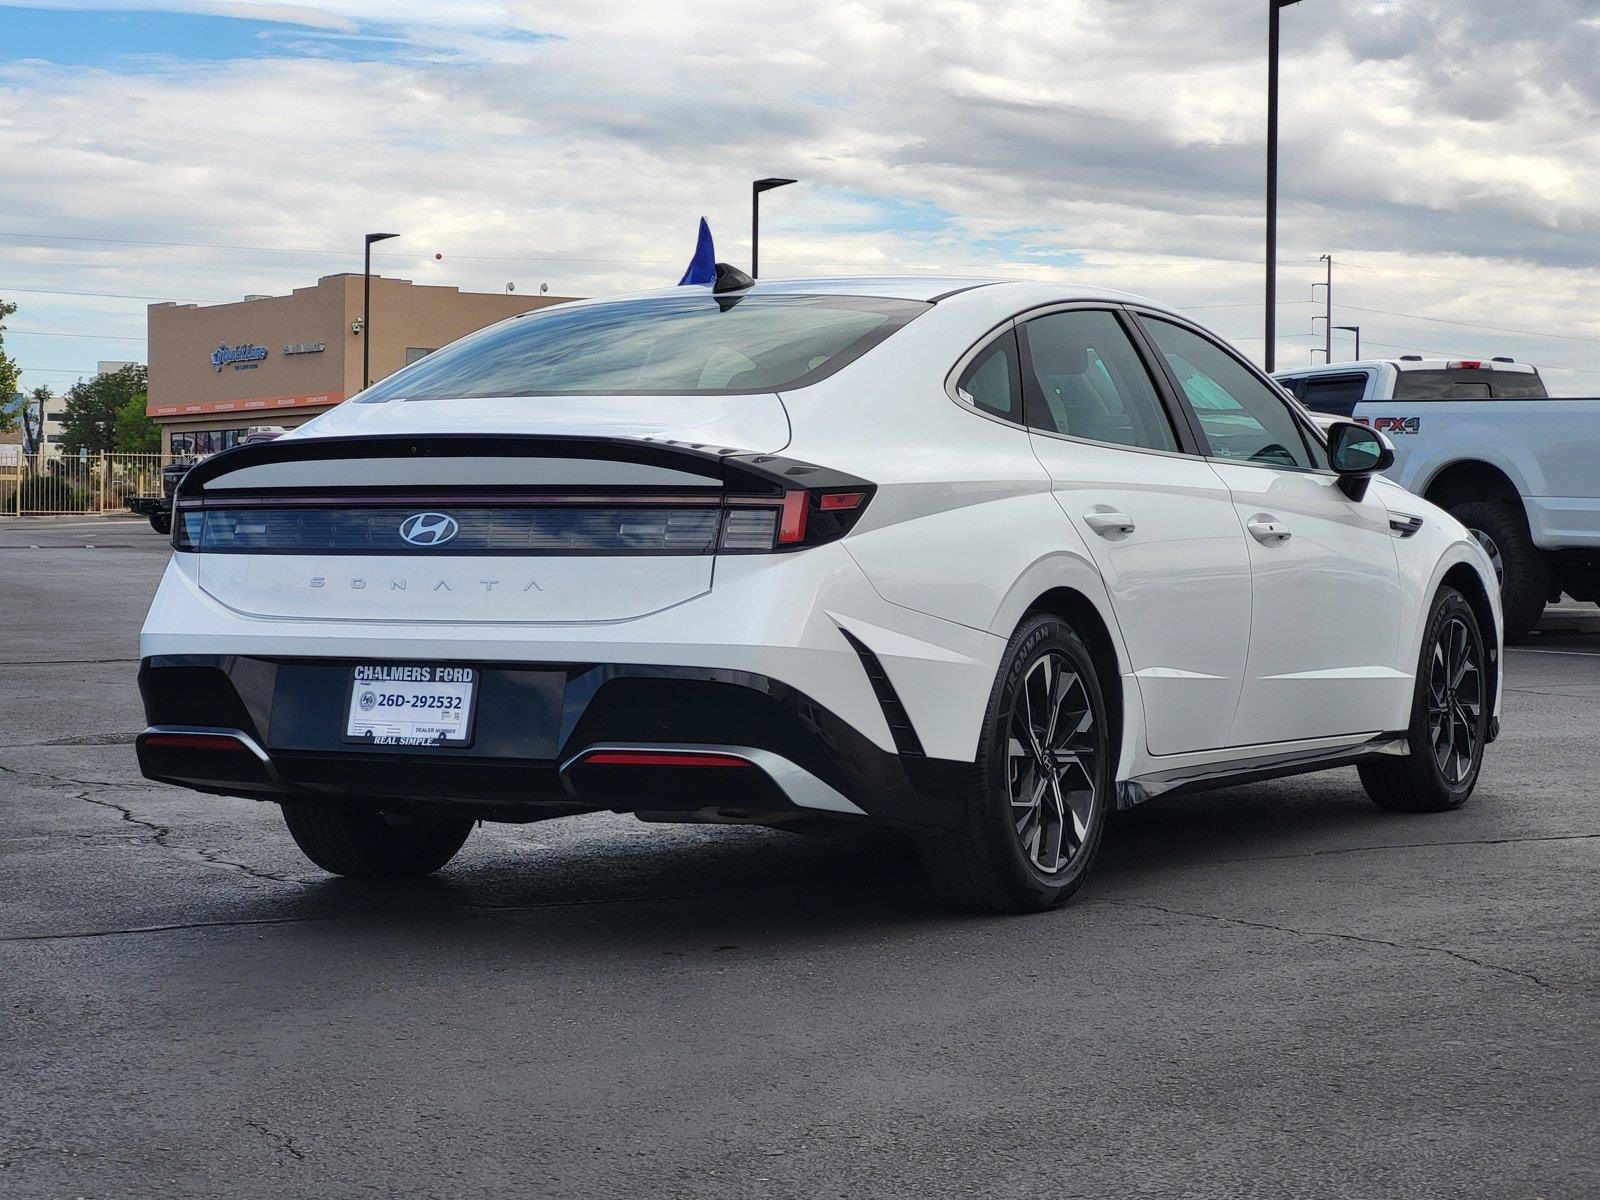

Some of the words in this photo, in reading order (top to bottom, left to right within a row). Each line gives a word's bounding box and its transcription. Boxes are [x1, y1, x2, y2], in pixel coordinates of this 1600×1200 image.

[1375, 417, 1420, 431] FX4
[309, 576, 544, 592] SONATA
[1007, 626, 1049, 694] IRONMAN
[354, 665, 430, 681] CHALMERS
[435, 667, 473, 682] FORD
[378, 693, 462, 710] 26D-292532
[373, 736, 397, 745] REAL
